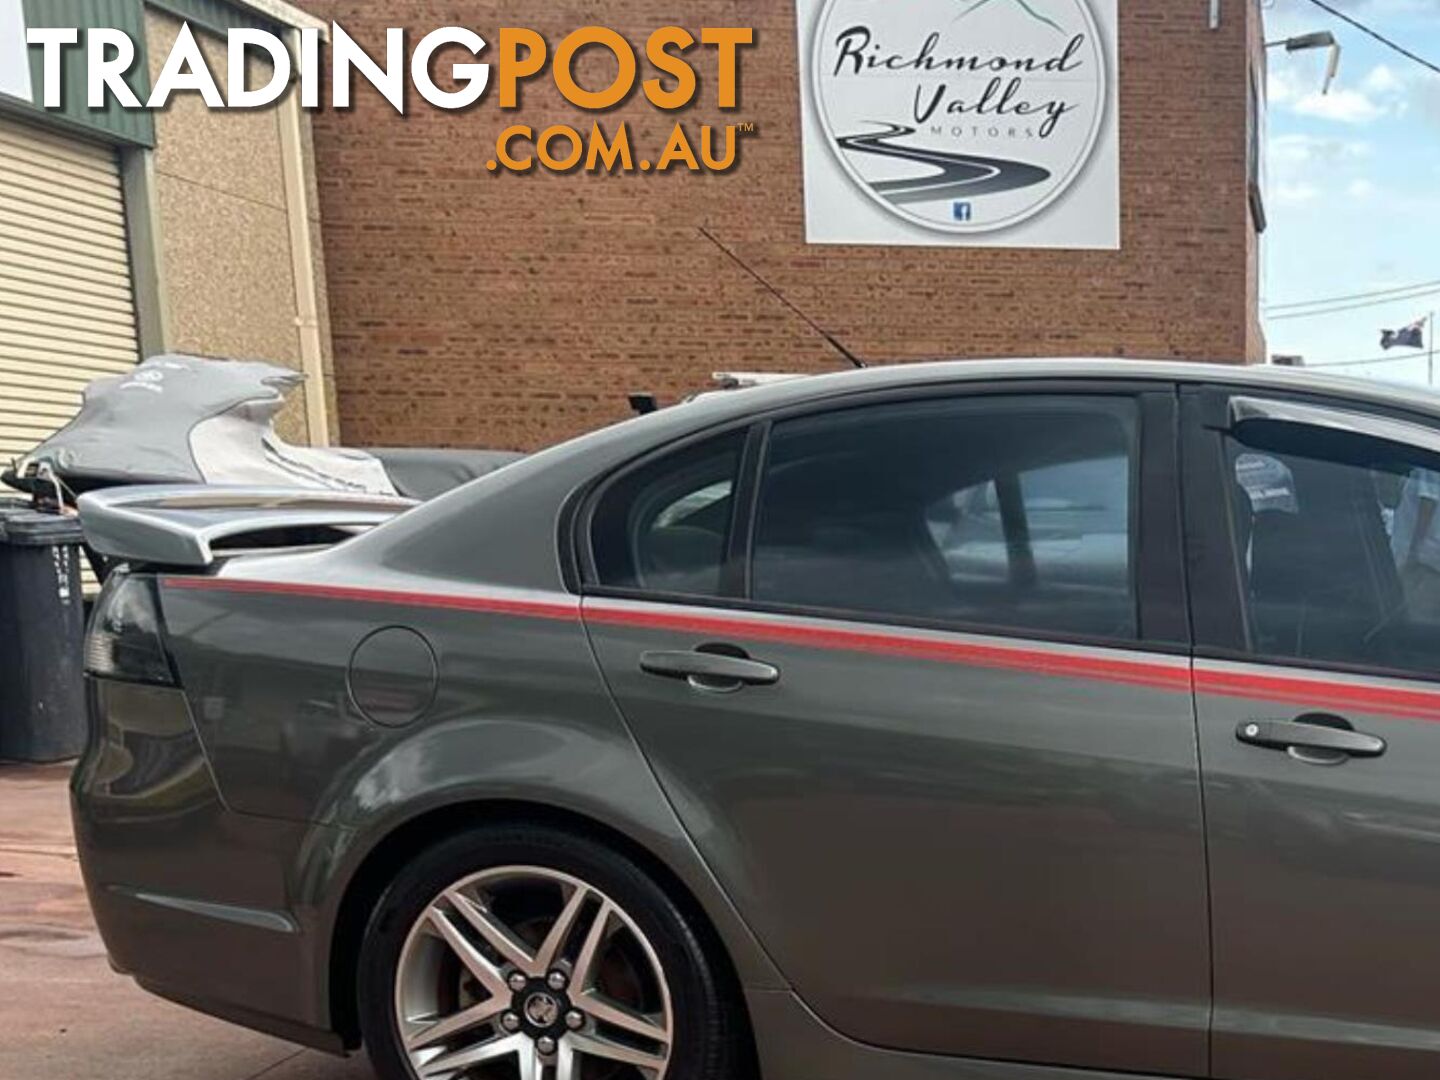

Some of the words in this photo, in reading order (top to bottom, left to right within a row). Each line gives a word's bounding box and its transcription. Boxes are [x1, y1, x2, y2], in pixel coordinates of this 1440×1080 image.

[833, 26, 1084, 76] Richmond
[914, 77, 1078, 138] Valley
[930, 125, 1034, 138] MOTORS
